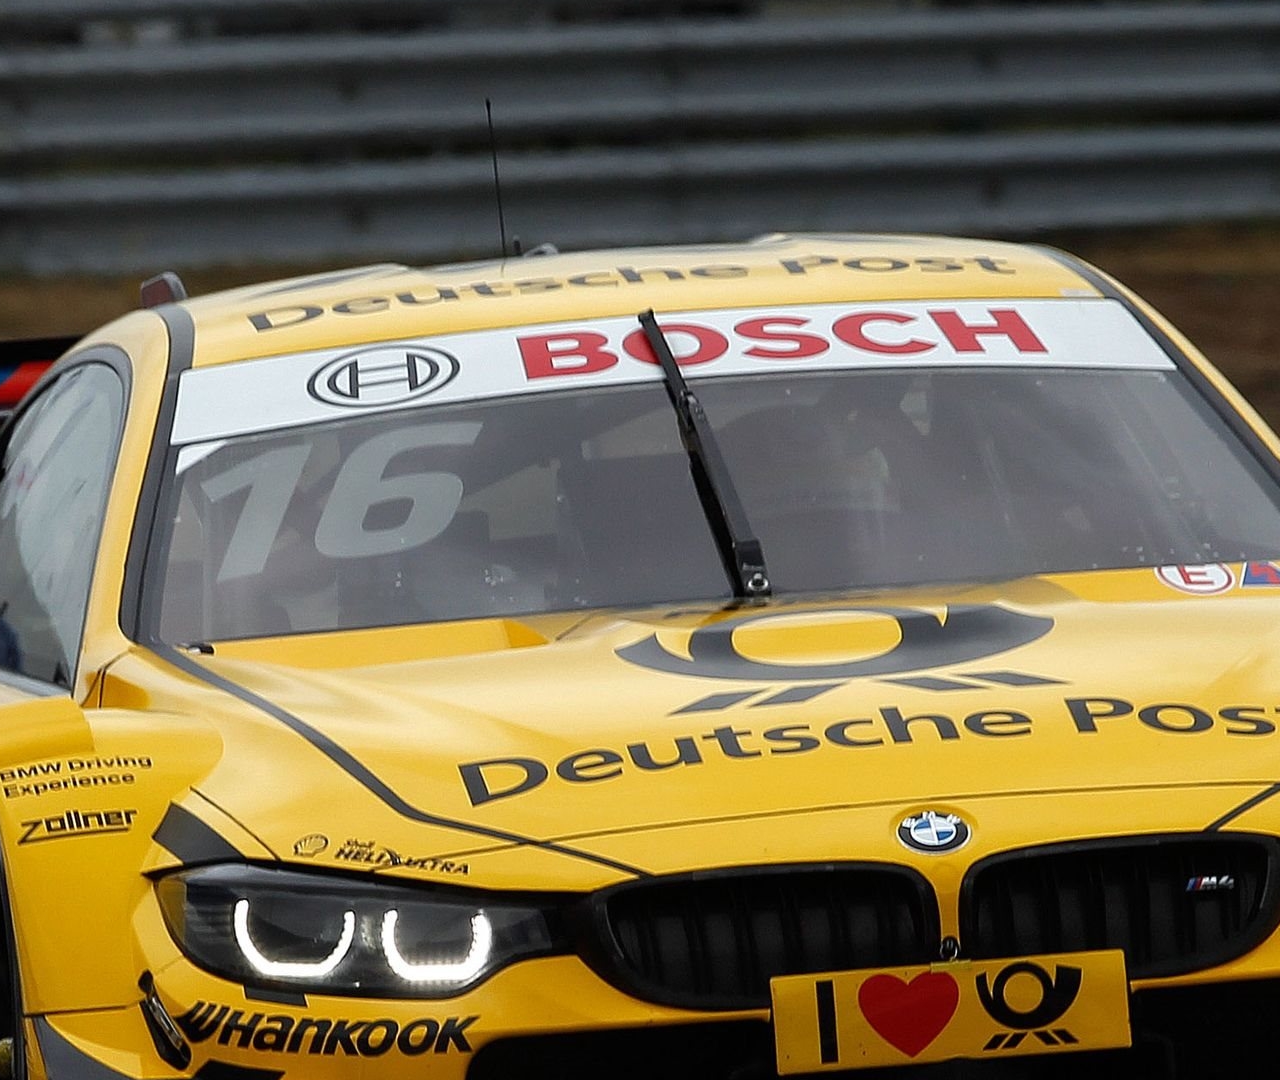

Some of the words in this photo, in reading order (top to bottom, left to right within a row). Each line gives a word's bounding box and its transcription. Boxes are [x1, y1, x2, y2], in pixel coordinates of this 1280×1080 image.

[247, 258, 750, 332] Deutsche
[780, 255, 1016, 275] Post
[516, 307, 1049, 382] BOSCH
[200, 421, 484, 583] 16
[0, 761, 62, 784] BMW
[67, 755, 153, 772] Driving
[2, 773, 136, 799] Experience
[457, 707, 1033, 807] Deutsche
[815, 979, 839, 1065] I
